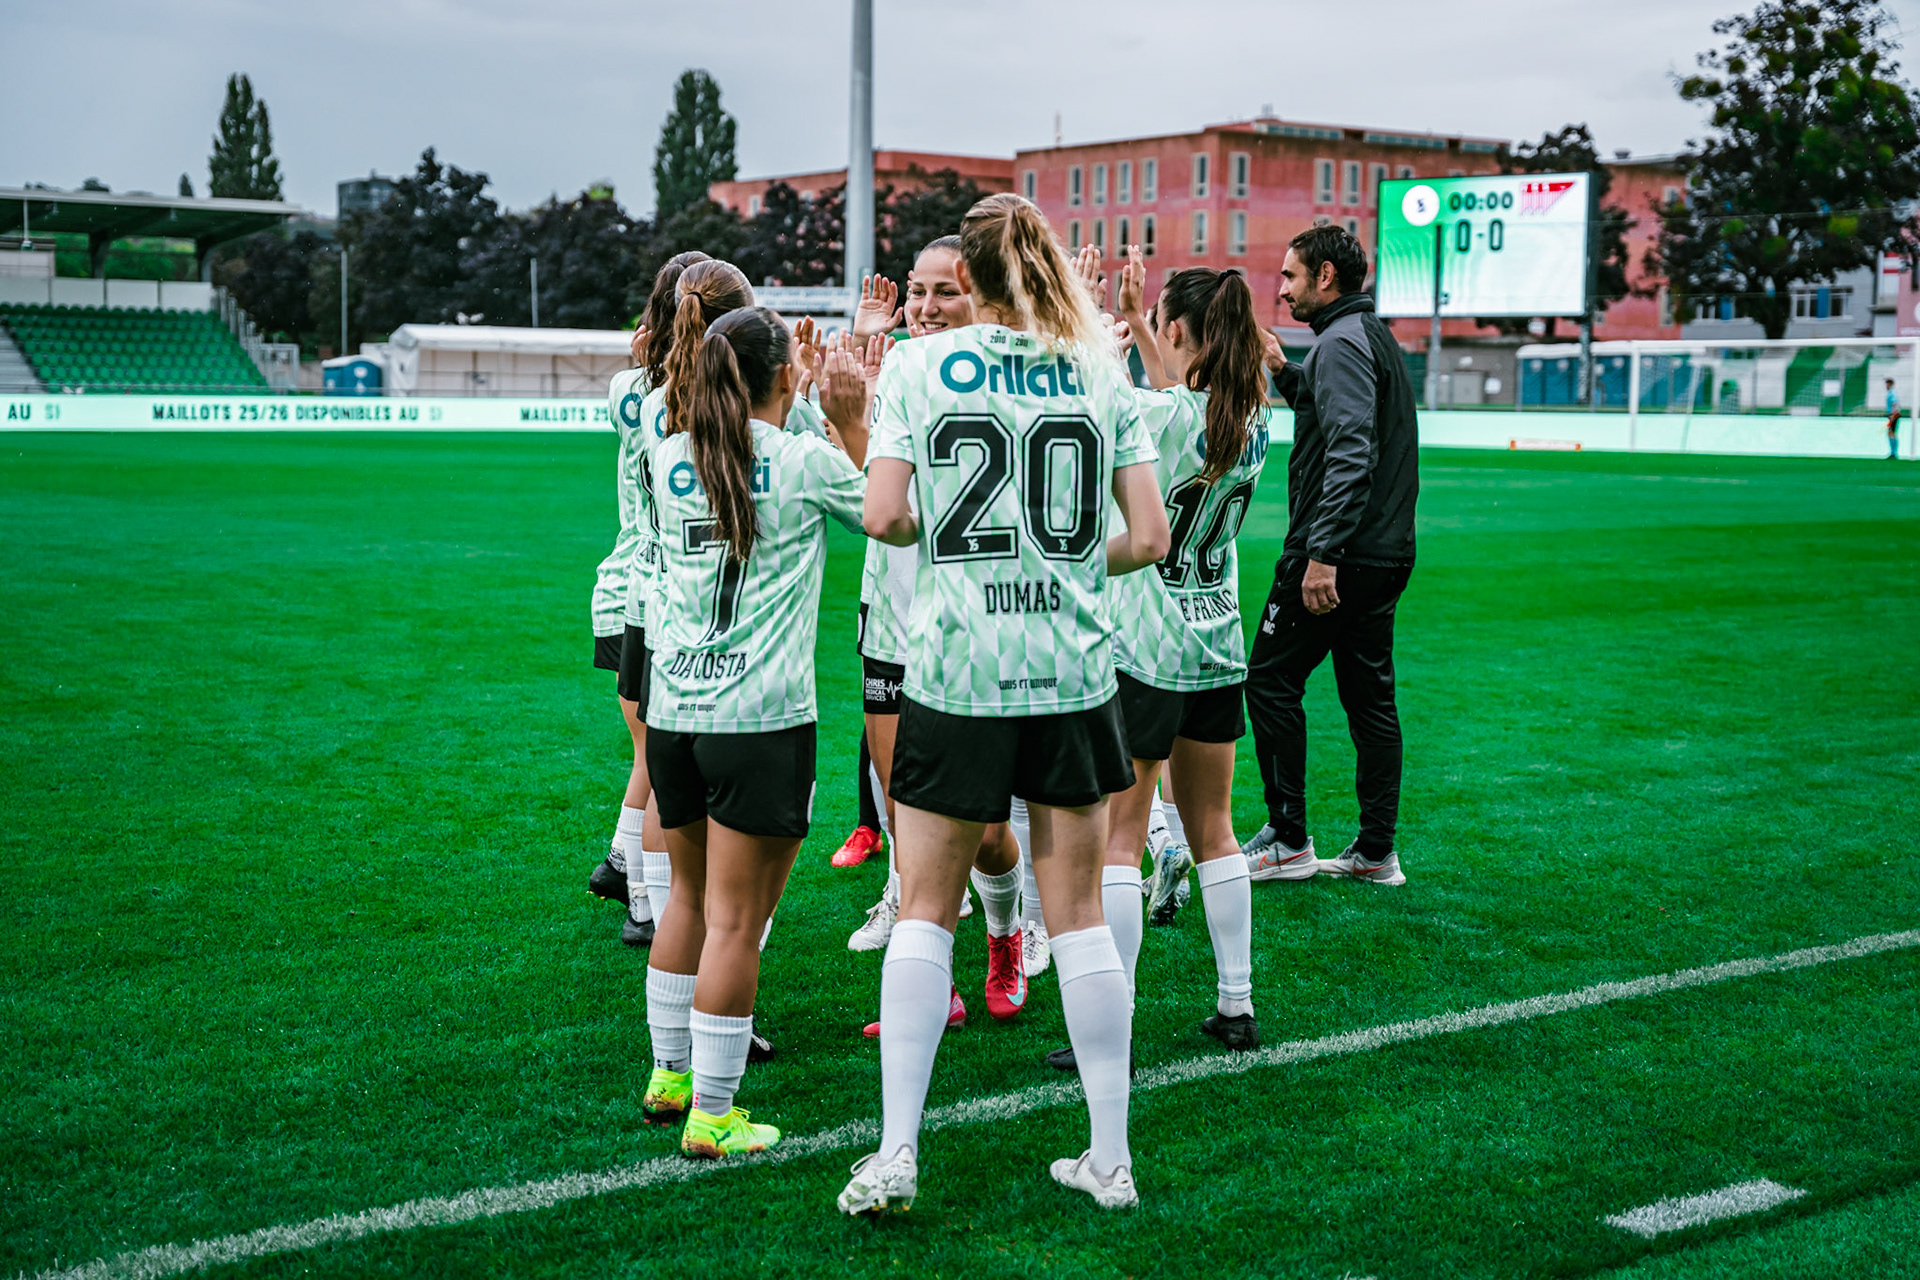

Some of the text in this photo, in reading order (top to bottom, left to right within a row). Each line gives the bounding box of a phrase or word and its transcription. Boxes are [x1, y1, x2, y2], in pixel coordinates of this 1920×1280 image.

[1450, 192, 1513, 211] 00:00
[8, 403, 31, 420] AU
[152, 404, 230, 420] MAILLOTS
[239, 405, 288, 421] 25/26
[296, 405, 392, 421] DISPONIBLES
[399, 406, 419, 421] AU
[520, 406, 586, 422] MAILLOTS
[927, 413, 1105, 564] 20
[1156, 474, 1255, 588] 10
[984, 580, 1061, 615] DUMAS
[865, 677, 886, 688] CHRIS
